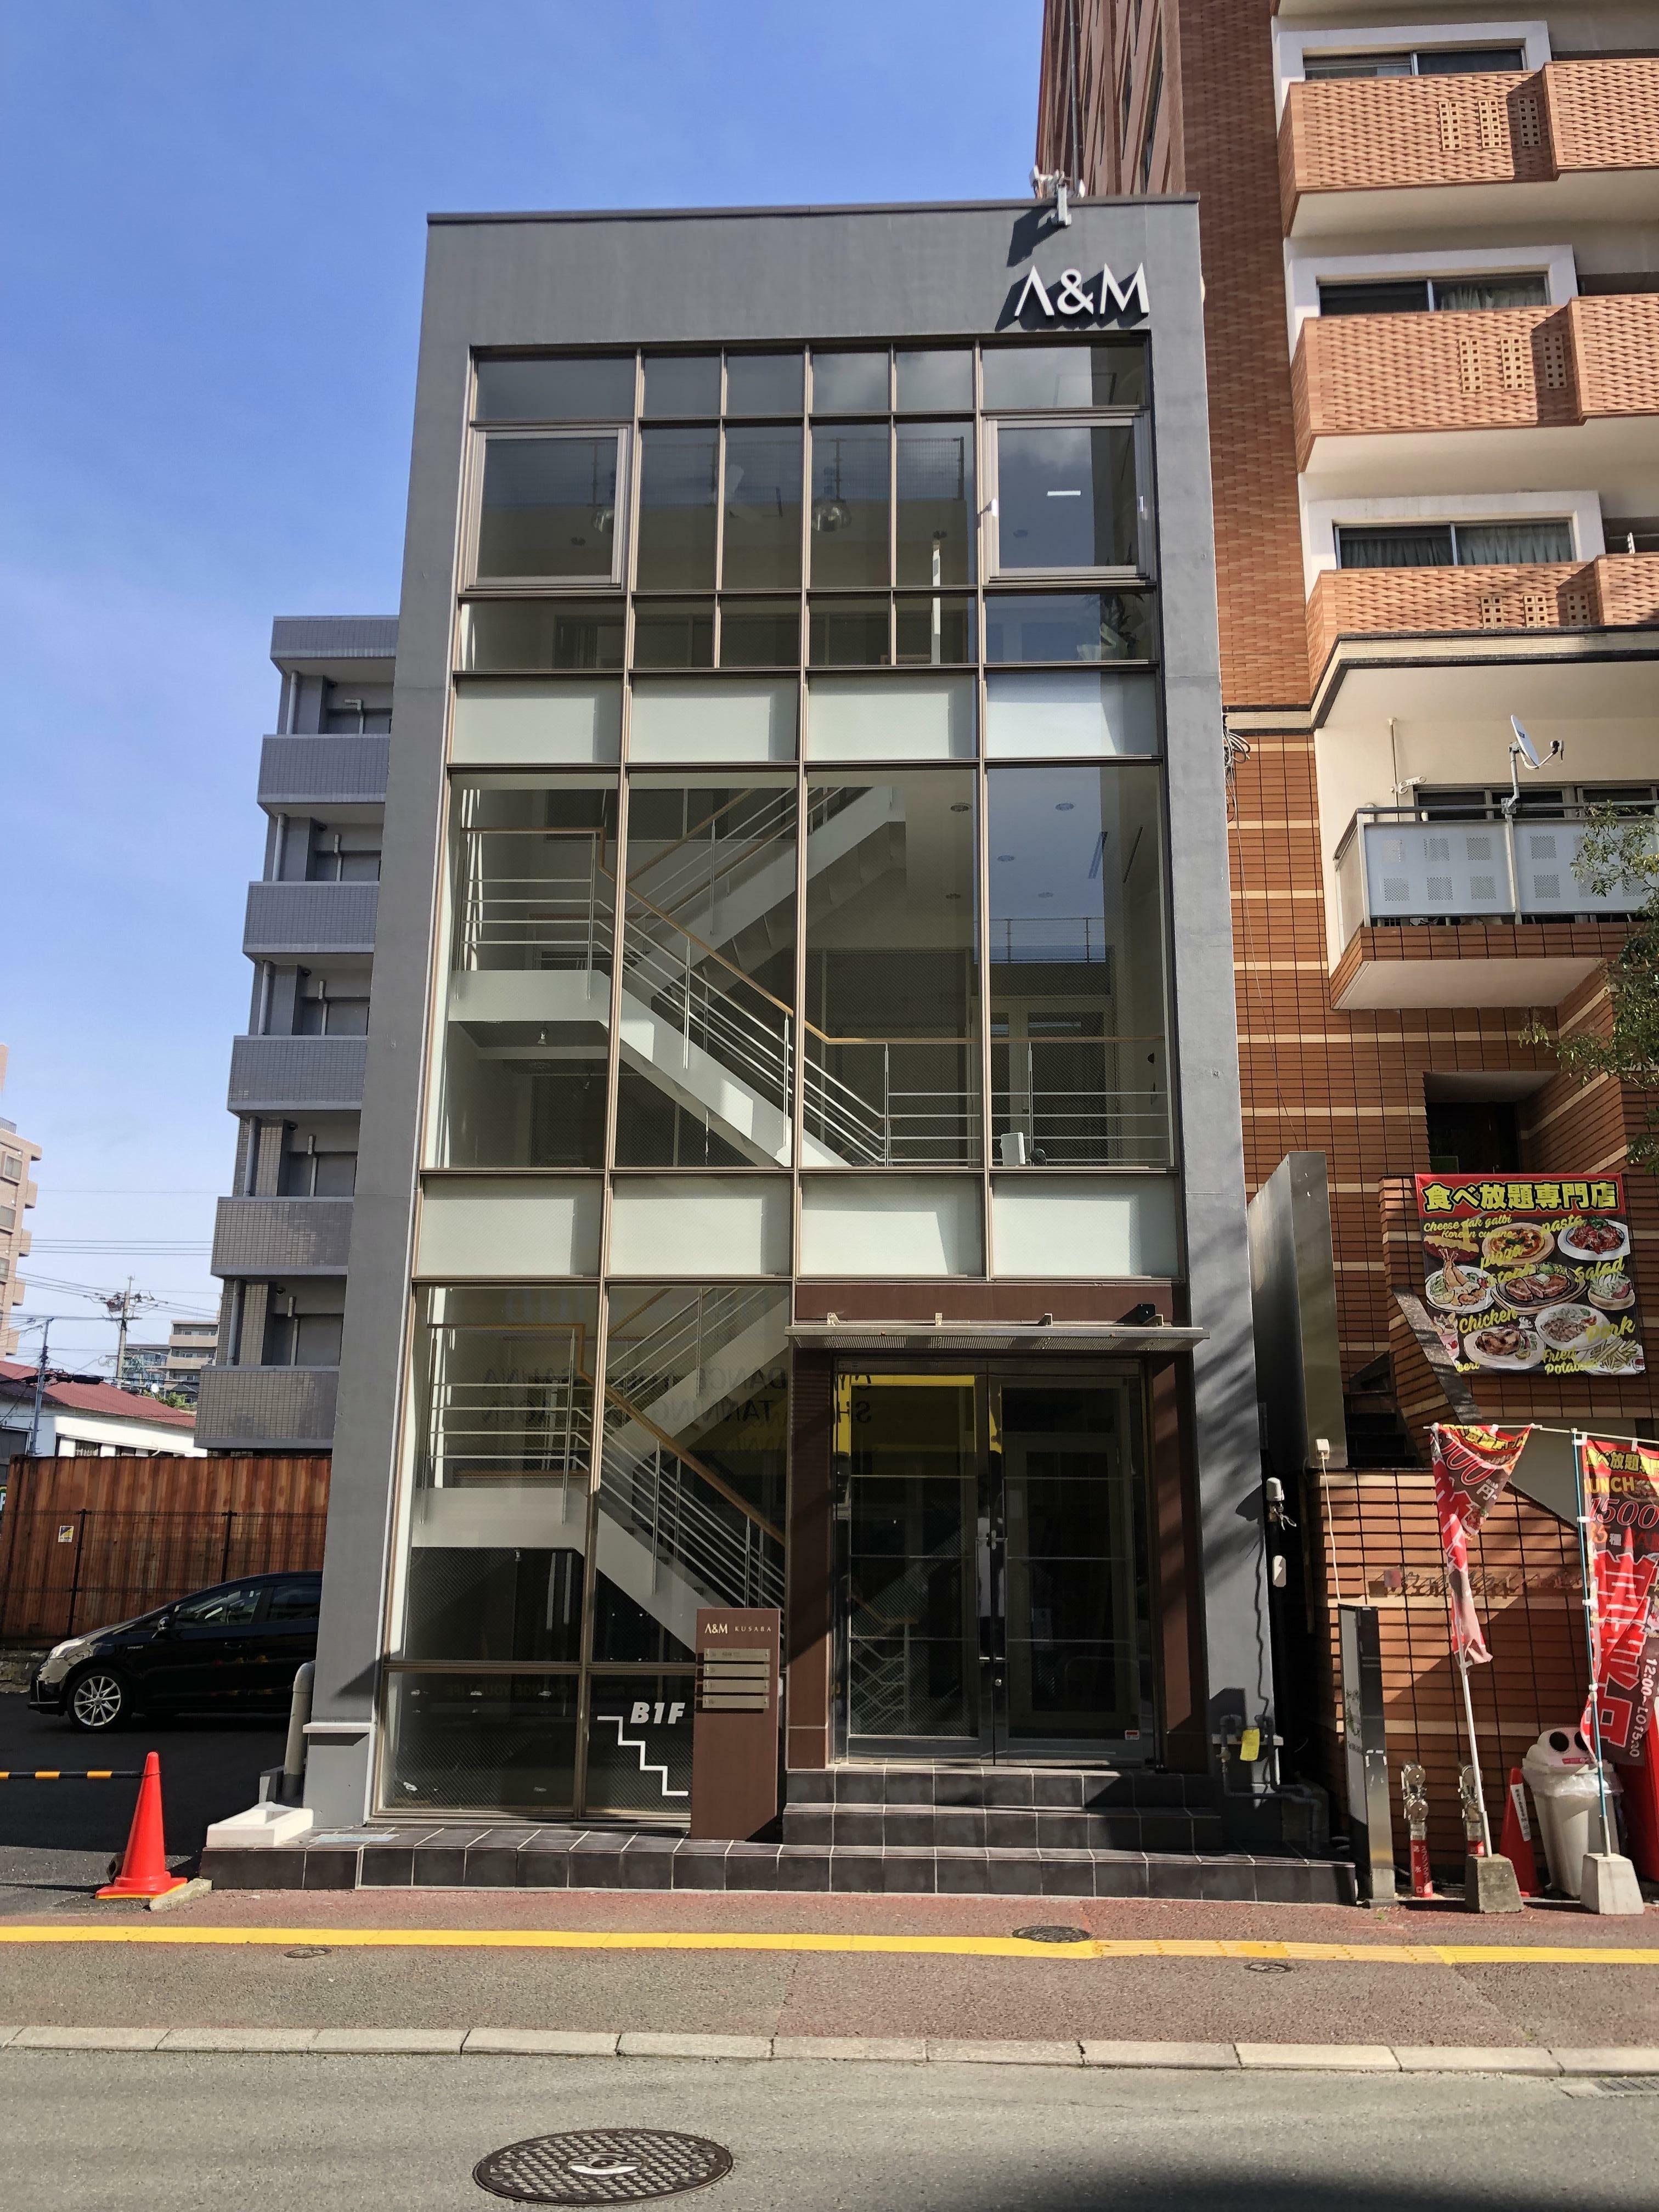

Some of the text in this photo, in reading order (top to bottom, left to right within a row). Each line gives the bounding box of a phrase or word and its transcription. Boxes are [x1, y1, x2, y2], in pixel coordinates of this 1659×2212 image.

[1423, 1181, 1618, 1212] 食べ放題専門店
[1424, 1221, 1460, 1232] Cheese
[1485, 1214, 1513, 1228] galbi
[630, 1702, 685, 1724] B1F
